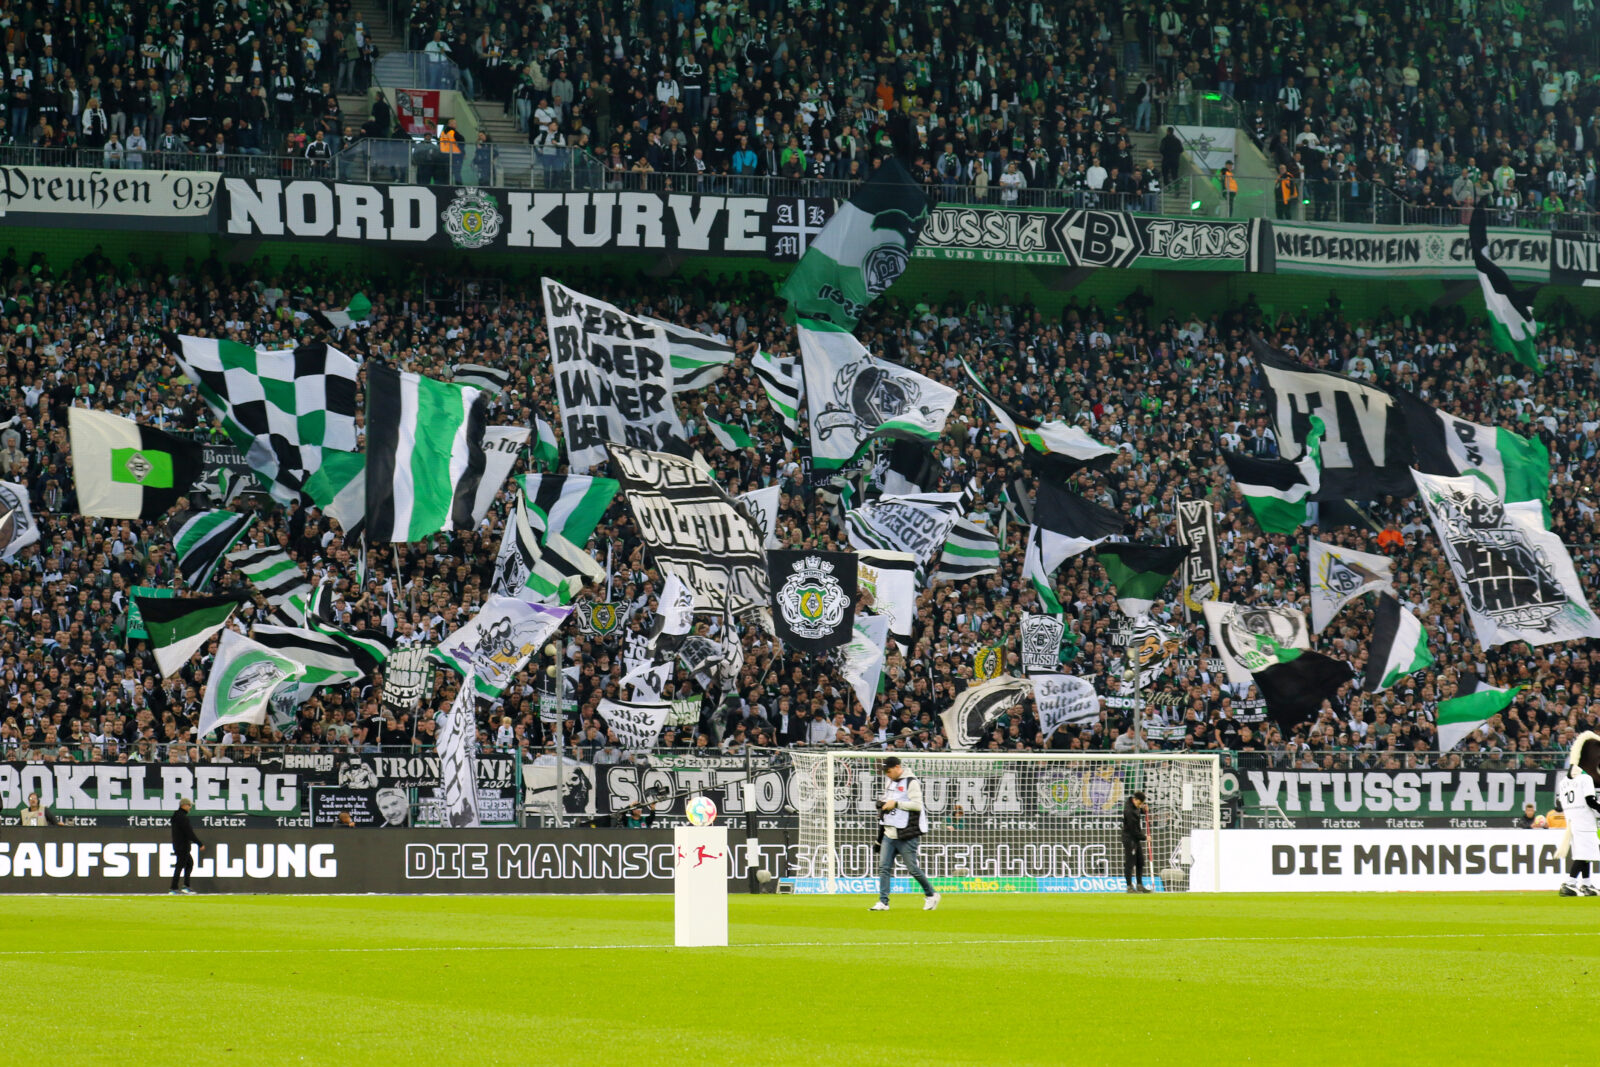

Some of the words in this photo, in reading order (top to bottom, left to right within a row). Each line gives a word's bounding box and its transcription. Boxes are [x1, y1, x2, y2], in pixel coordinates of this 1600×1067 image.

[0, 167, 151, 209] Preußen
[225, 178, 437, 240] NORD
[507, 192, 768, 250] KURVE
[918, 209, 1048, 252] USSIA
[1147, 221, 1249, 260] FANS
[1276, 231, 1421, 263] NIEDERRHEIN
[1450, 237, 1548, 263] CHOTEN
[384, 681, 421, 696] SOTT
[285, 754, 334, 768] BANDA
[649, 756, 770, 769] ASCENDENTE
[374, 756, 514, 781] FRONINE
[0, 765, 298, 811] BOKELBERG
[482, 779, 513, 790] 2006
[1247, 771, 1547, 812] VITUSSTADT
[127, 816, 172, 827] flatex
[202, 816, 246, 827] flatex
[276, 816, 310, 828] flate
[650, 818, 692, 829] atex
[724, 818, 778, 830] flaex
[1322, 818, 1360, 829] flatex
[1386, 818, 1424, 829] flatex
[1449, 818, 1487, 829] flatex
[406, 843, 488, 879] DIE
[1272, 844, 1342, 876] DIE
[1354, 844, 1600, 876] MANNSCHA
[1072, 878, 1136, 892] JONGE
